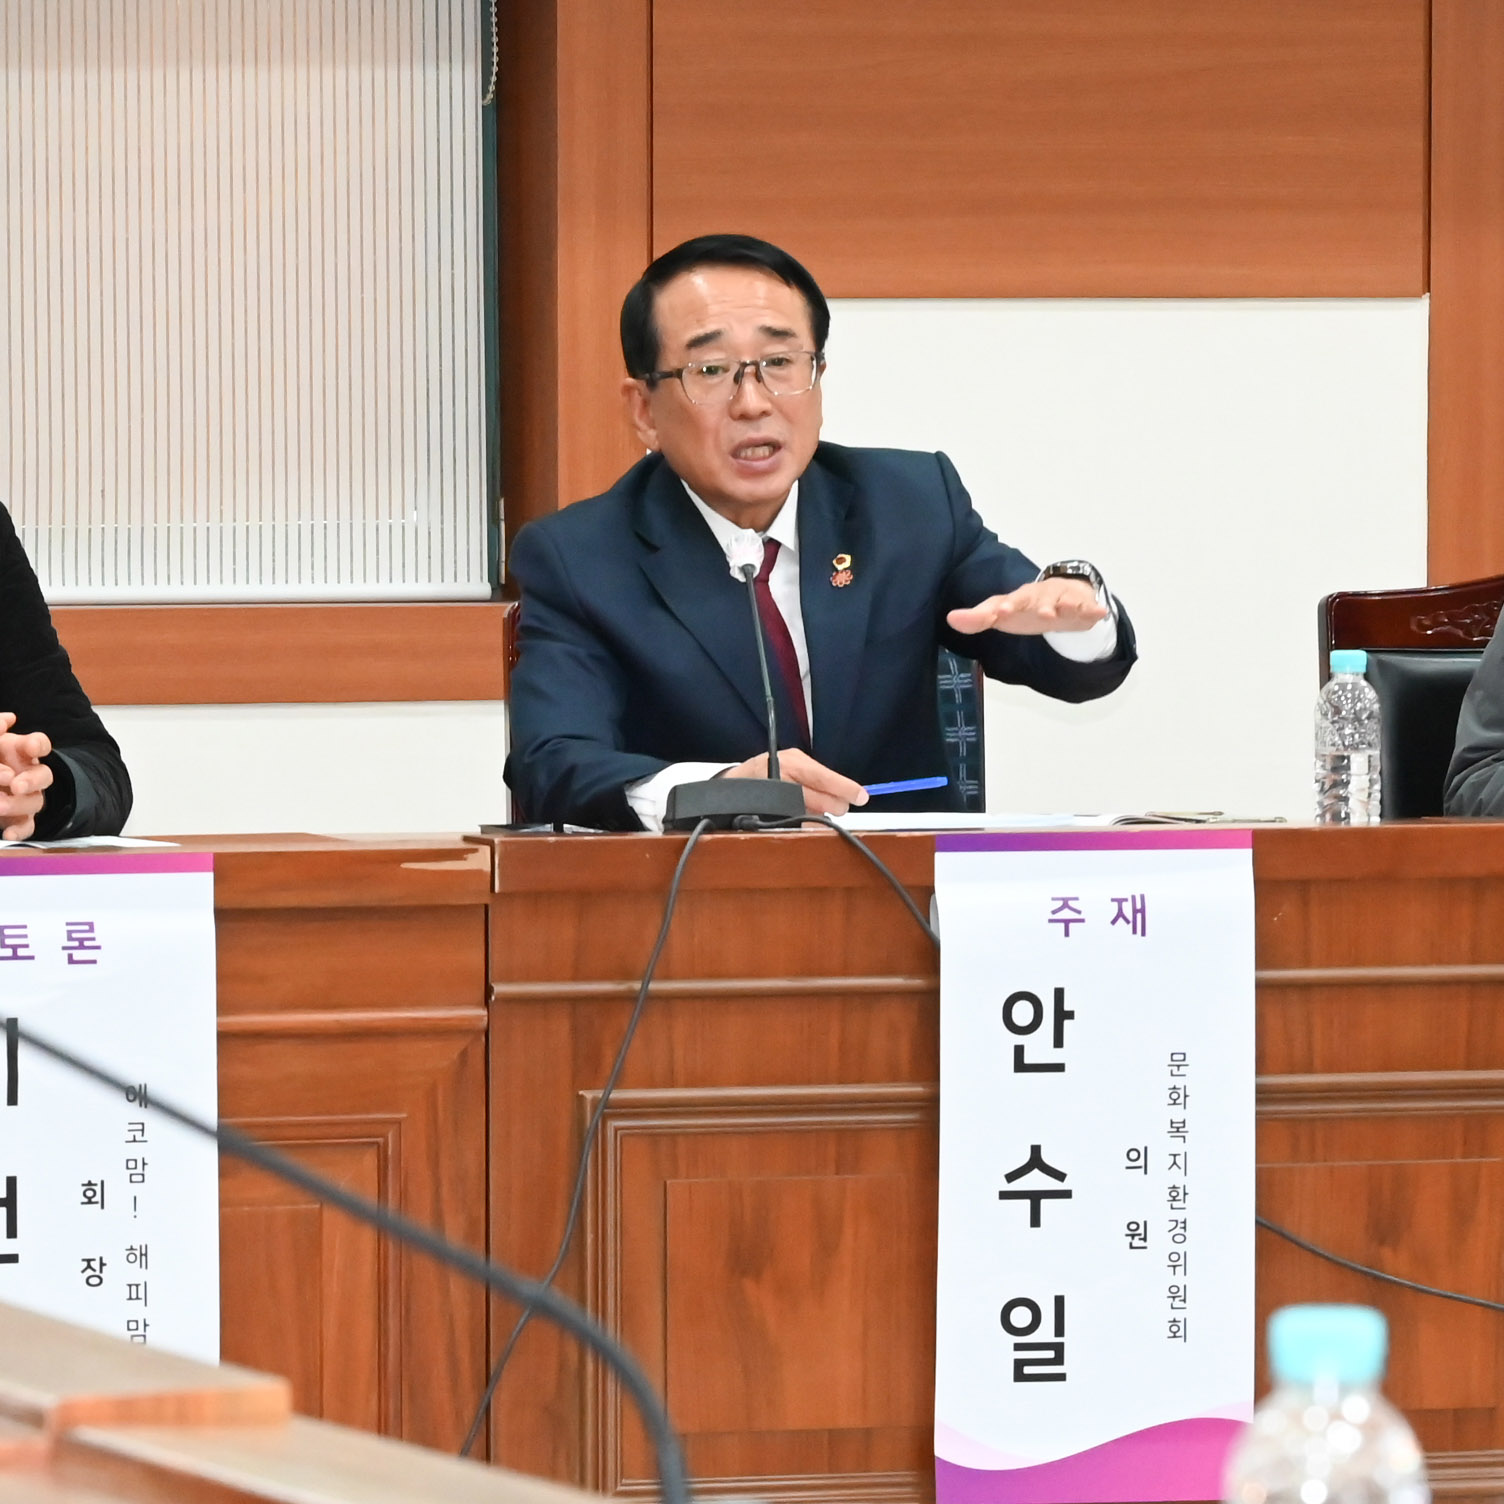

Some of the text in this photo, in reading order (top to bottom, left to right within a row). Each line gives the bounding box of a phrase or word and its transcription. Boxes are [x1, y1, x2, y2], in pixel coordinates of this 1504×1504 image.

[1047, 893, 1147, 938] 주재
[80, 1179, 108, 1288] 회장
[998, 986, 1076, 1383] 안수일
[1124, 1145, 1149, 1250] 의원
[1166, 1052, 1190, 1343] 문화복지환경위원회
[124, 1243, 150, 1346] 해피맘
